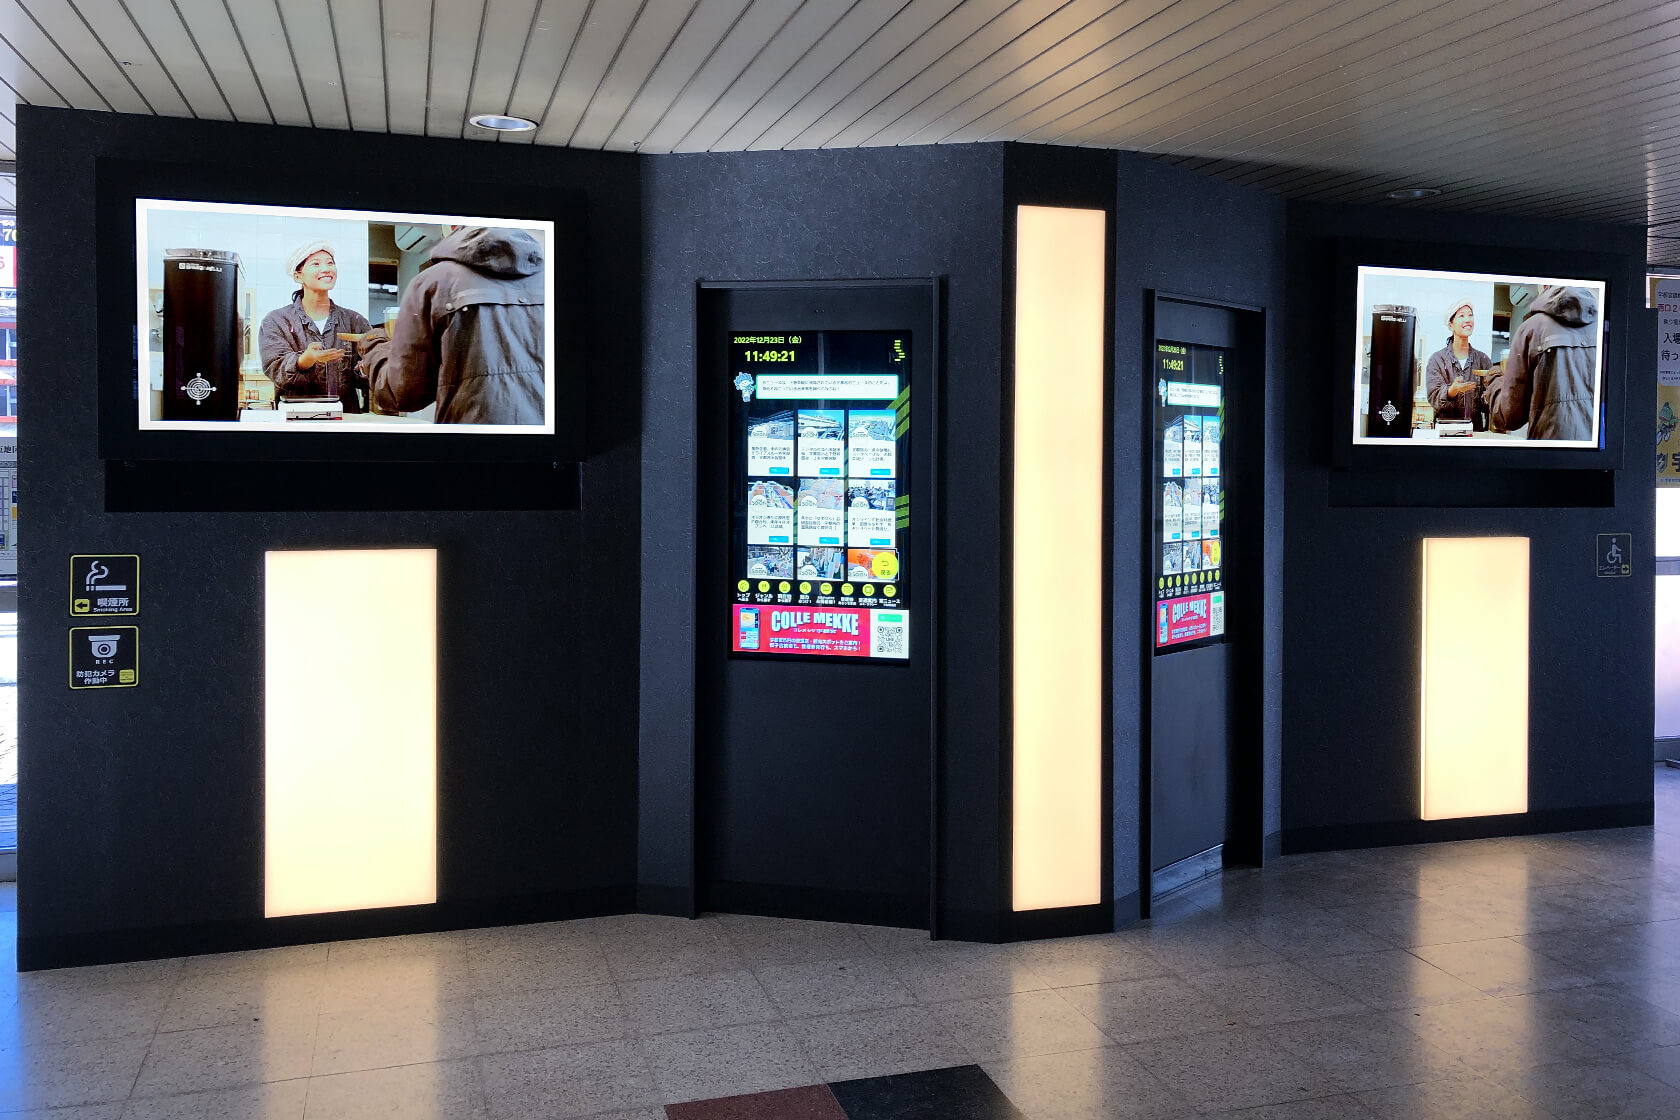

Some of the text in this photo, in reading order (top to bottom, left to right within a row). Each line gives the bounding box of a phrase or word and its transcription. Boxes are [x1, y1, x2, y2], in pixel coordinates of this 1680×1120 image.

[745, 350, 795, 361] 11:49:21
[97, 598, 129, 606] 喫煙所
[1172, 601, 1189, 624] COLLE
[771, 611, 859, 636] COLLE MEKKE
